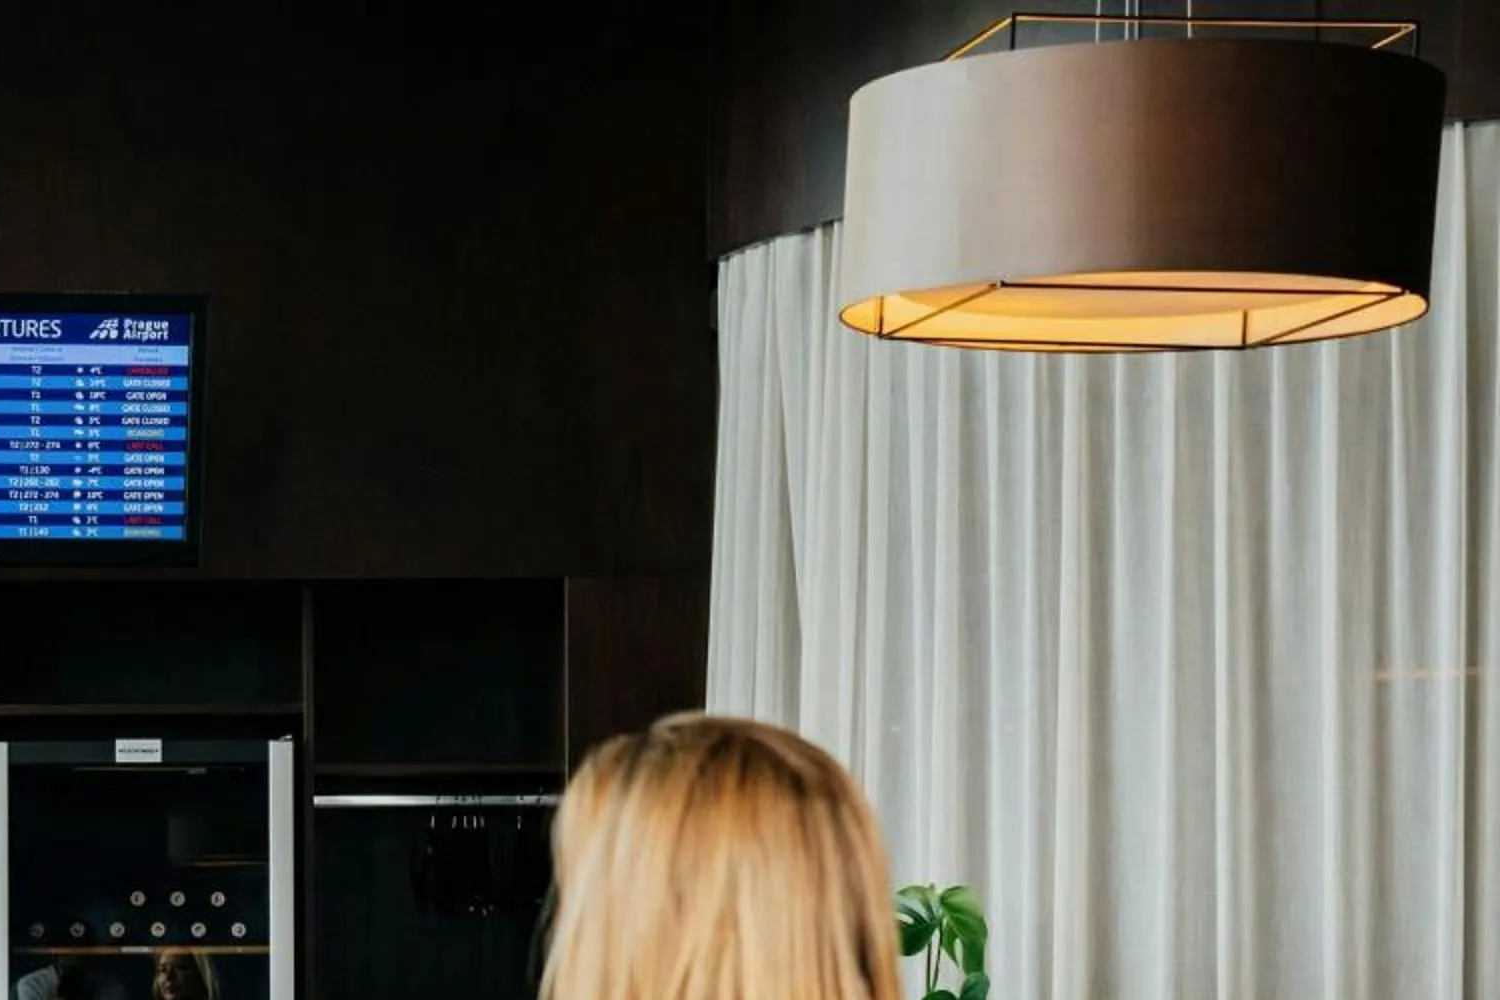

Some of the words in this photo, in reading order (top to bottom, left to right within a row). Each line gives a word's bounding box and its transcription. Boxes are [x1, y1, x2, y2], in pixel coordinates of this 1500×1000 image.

[123, 318, 169, 331] Prague
[123, 330, 169, 342] Airport
[30, 415, 41, 424] T2
[143, 467, 164, 475] OPEN
[143, 491, 164, 500] OPEN
